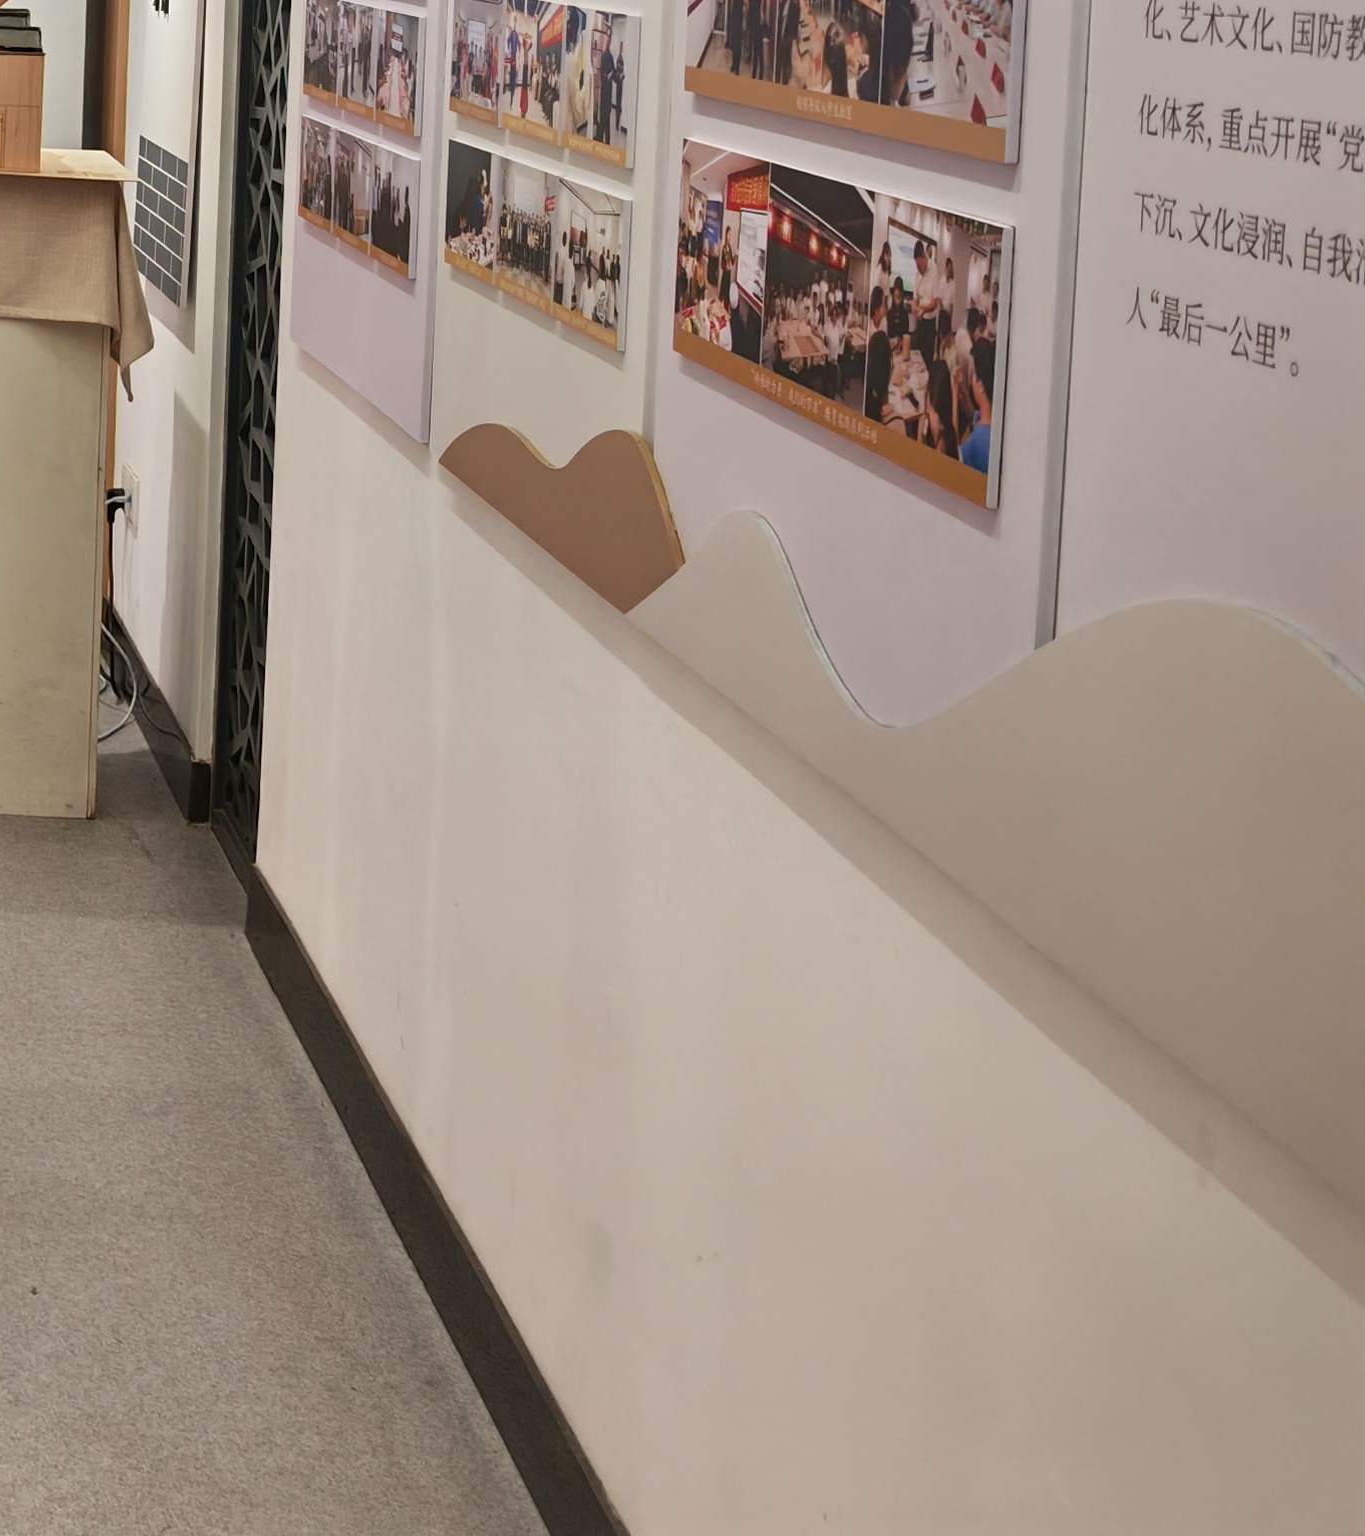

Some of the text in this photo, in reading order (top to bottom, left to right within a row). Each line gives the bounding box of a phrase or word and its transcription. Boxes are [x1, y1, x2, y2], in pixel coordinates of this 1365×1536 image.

[1126, 286, 1300, 378] 人“最后一公里”。
